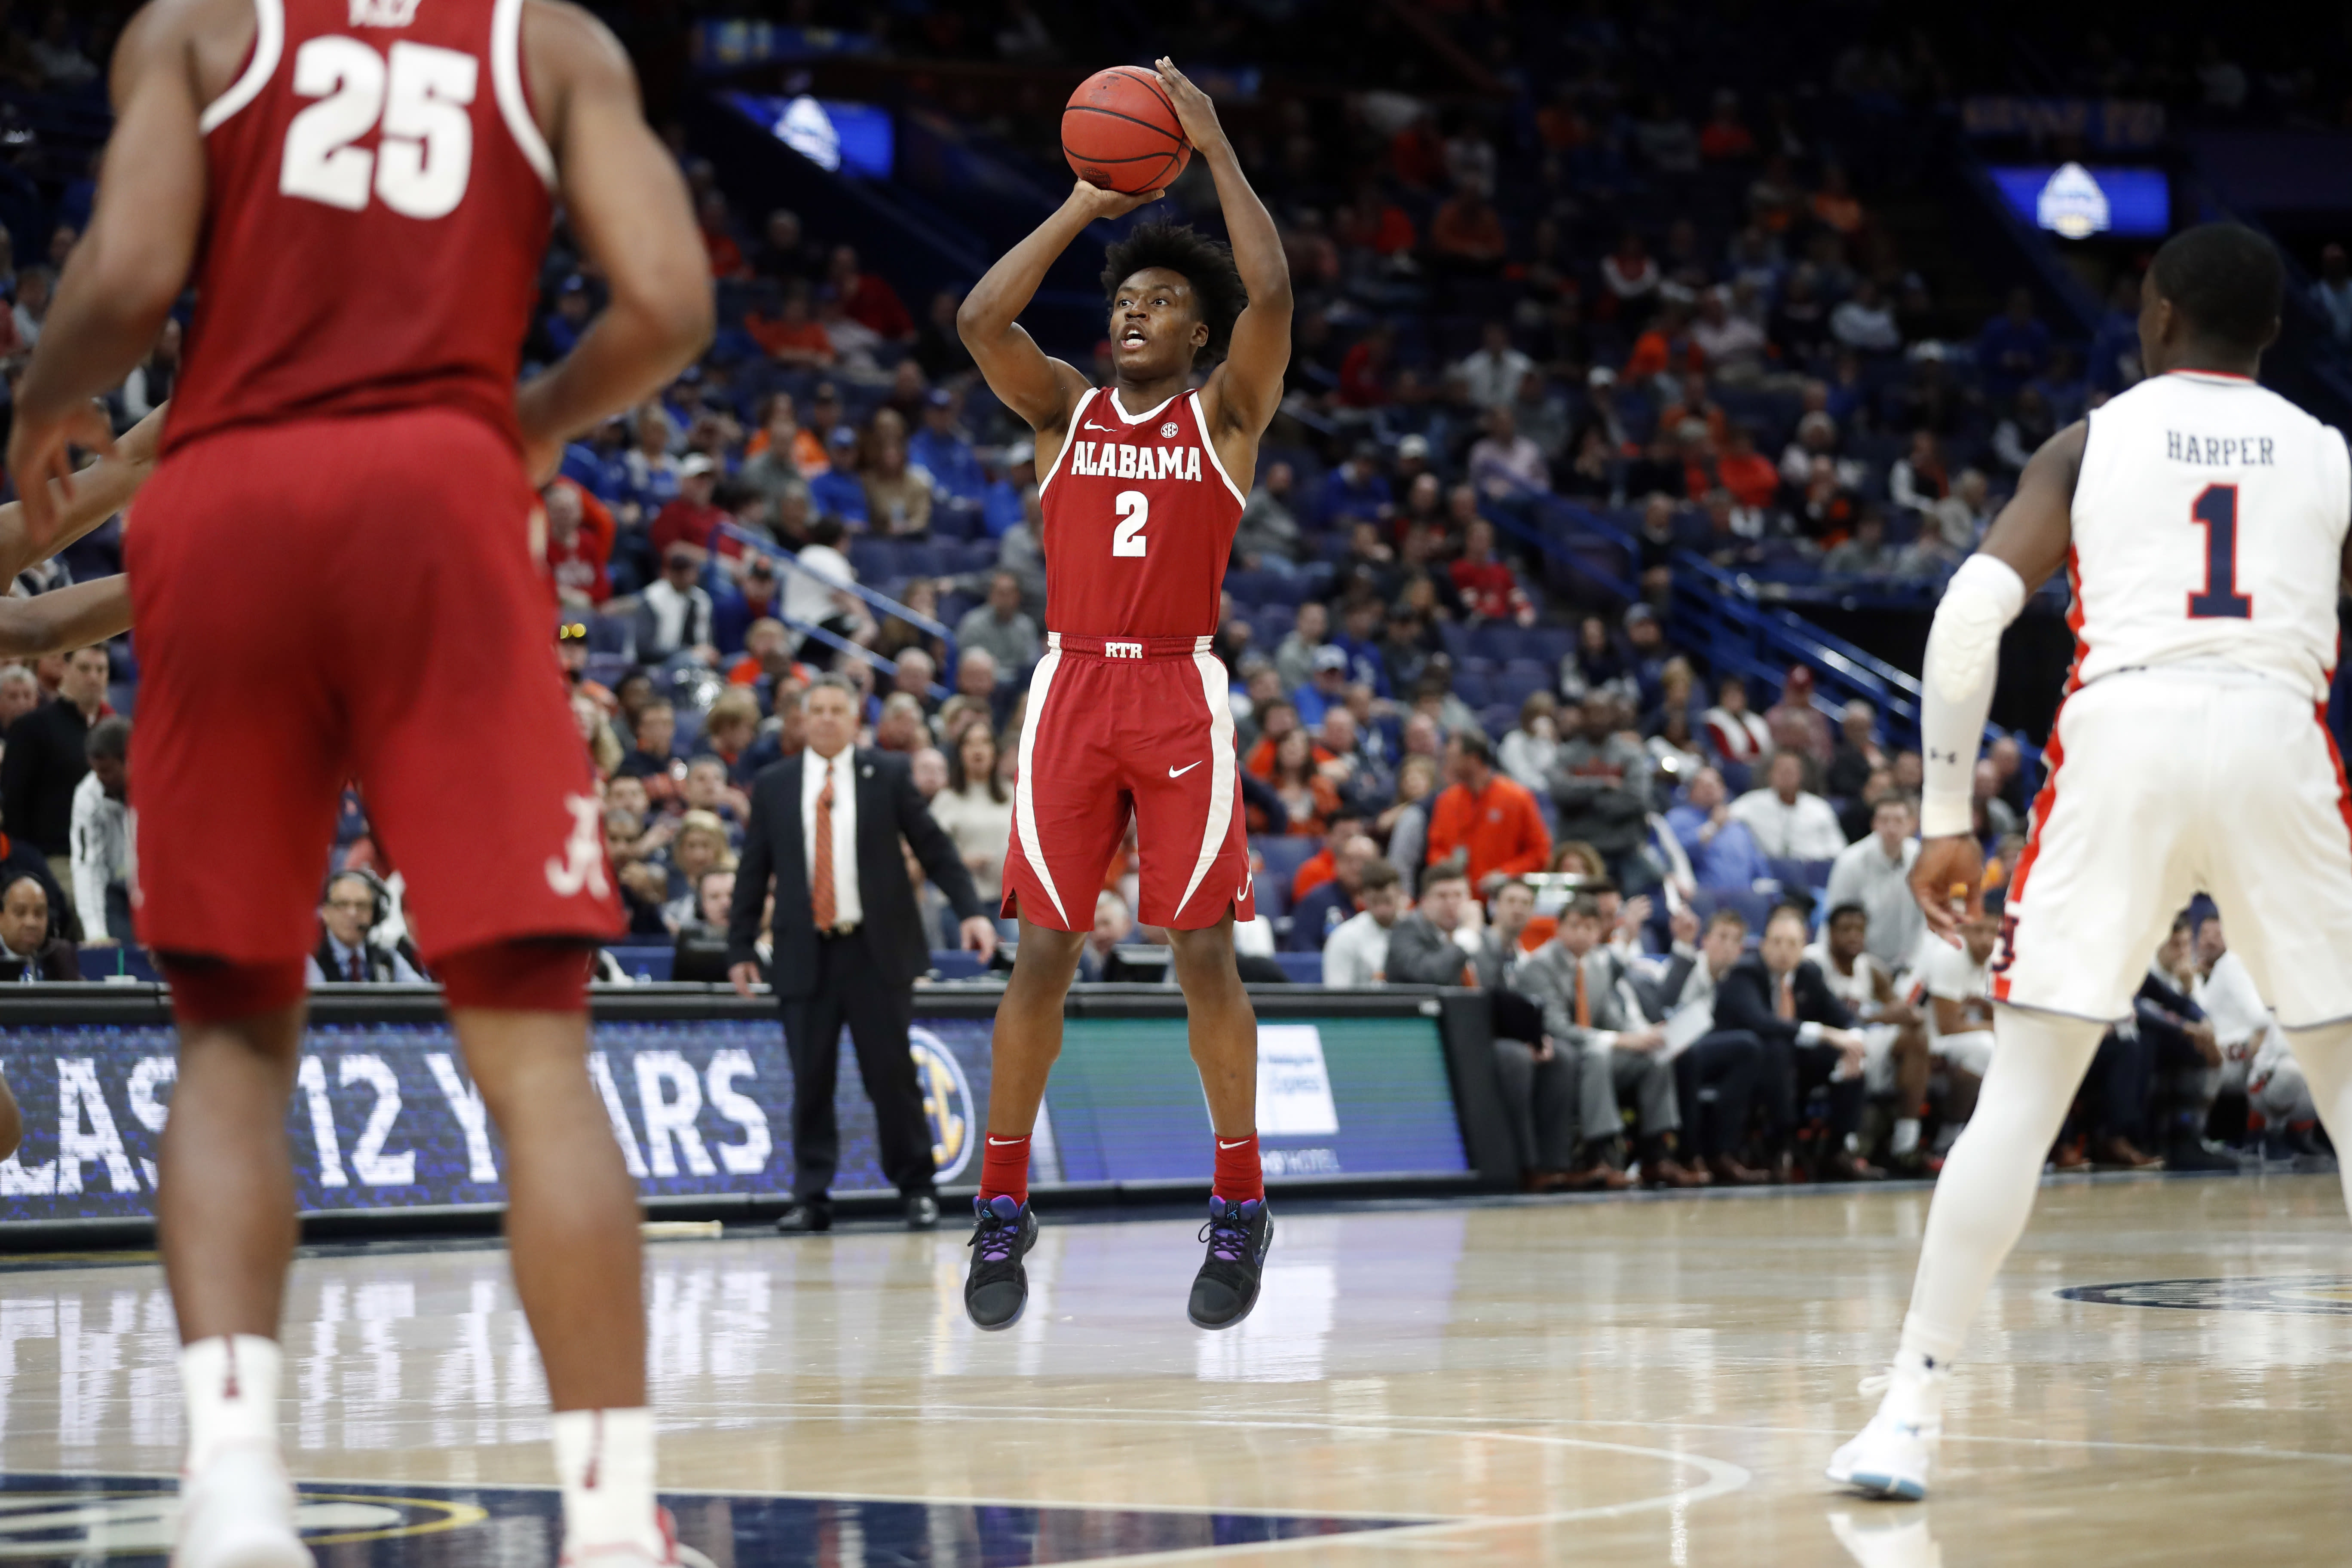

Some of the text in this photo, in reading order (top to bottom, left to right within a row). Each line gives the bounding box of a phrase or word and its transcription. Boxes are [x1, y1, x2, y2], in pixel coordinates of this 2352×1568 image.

[279, 34, 478, 220] 25
[1162, 424, 1177, 437] SEC
[2168, 430, 2274, 466] HARPER
[1071, 441, 1201, 482] ALABAMA
[1113, 490, 1148, 557] 2
[2187, 483, 2252, 619] 1
[1105, 642, 1142, 658] RTR
[0, 1056, 178, 1196] LAS
[298, 1054, 416, 1188] 12
